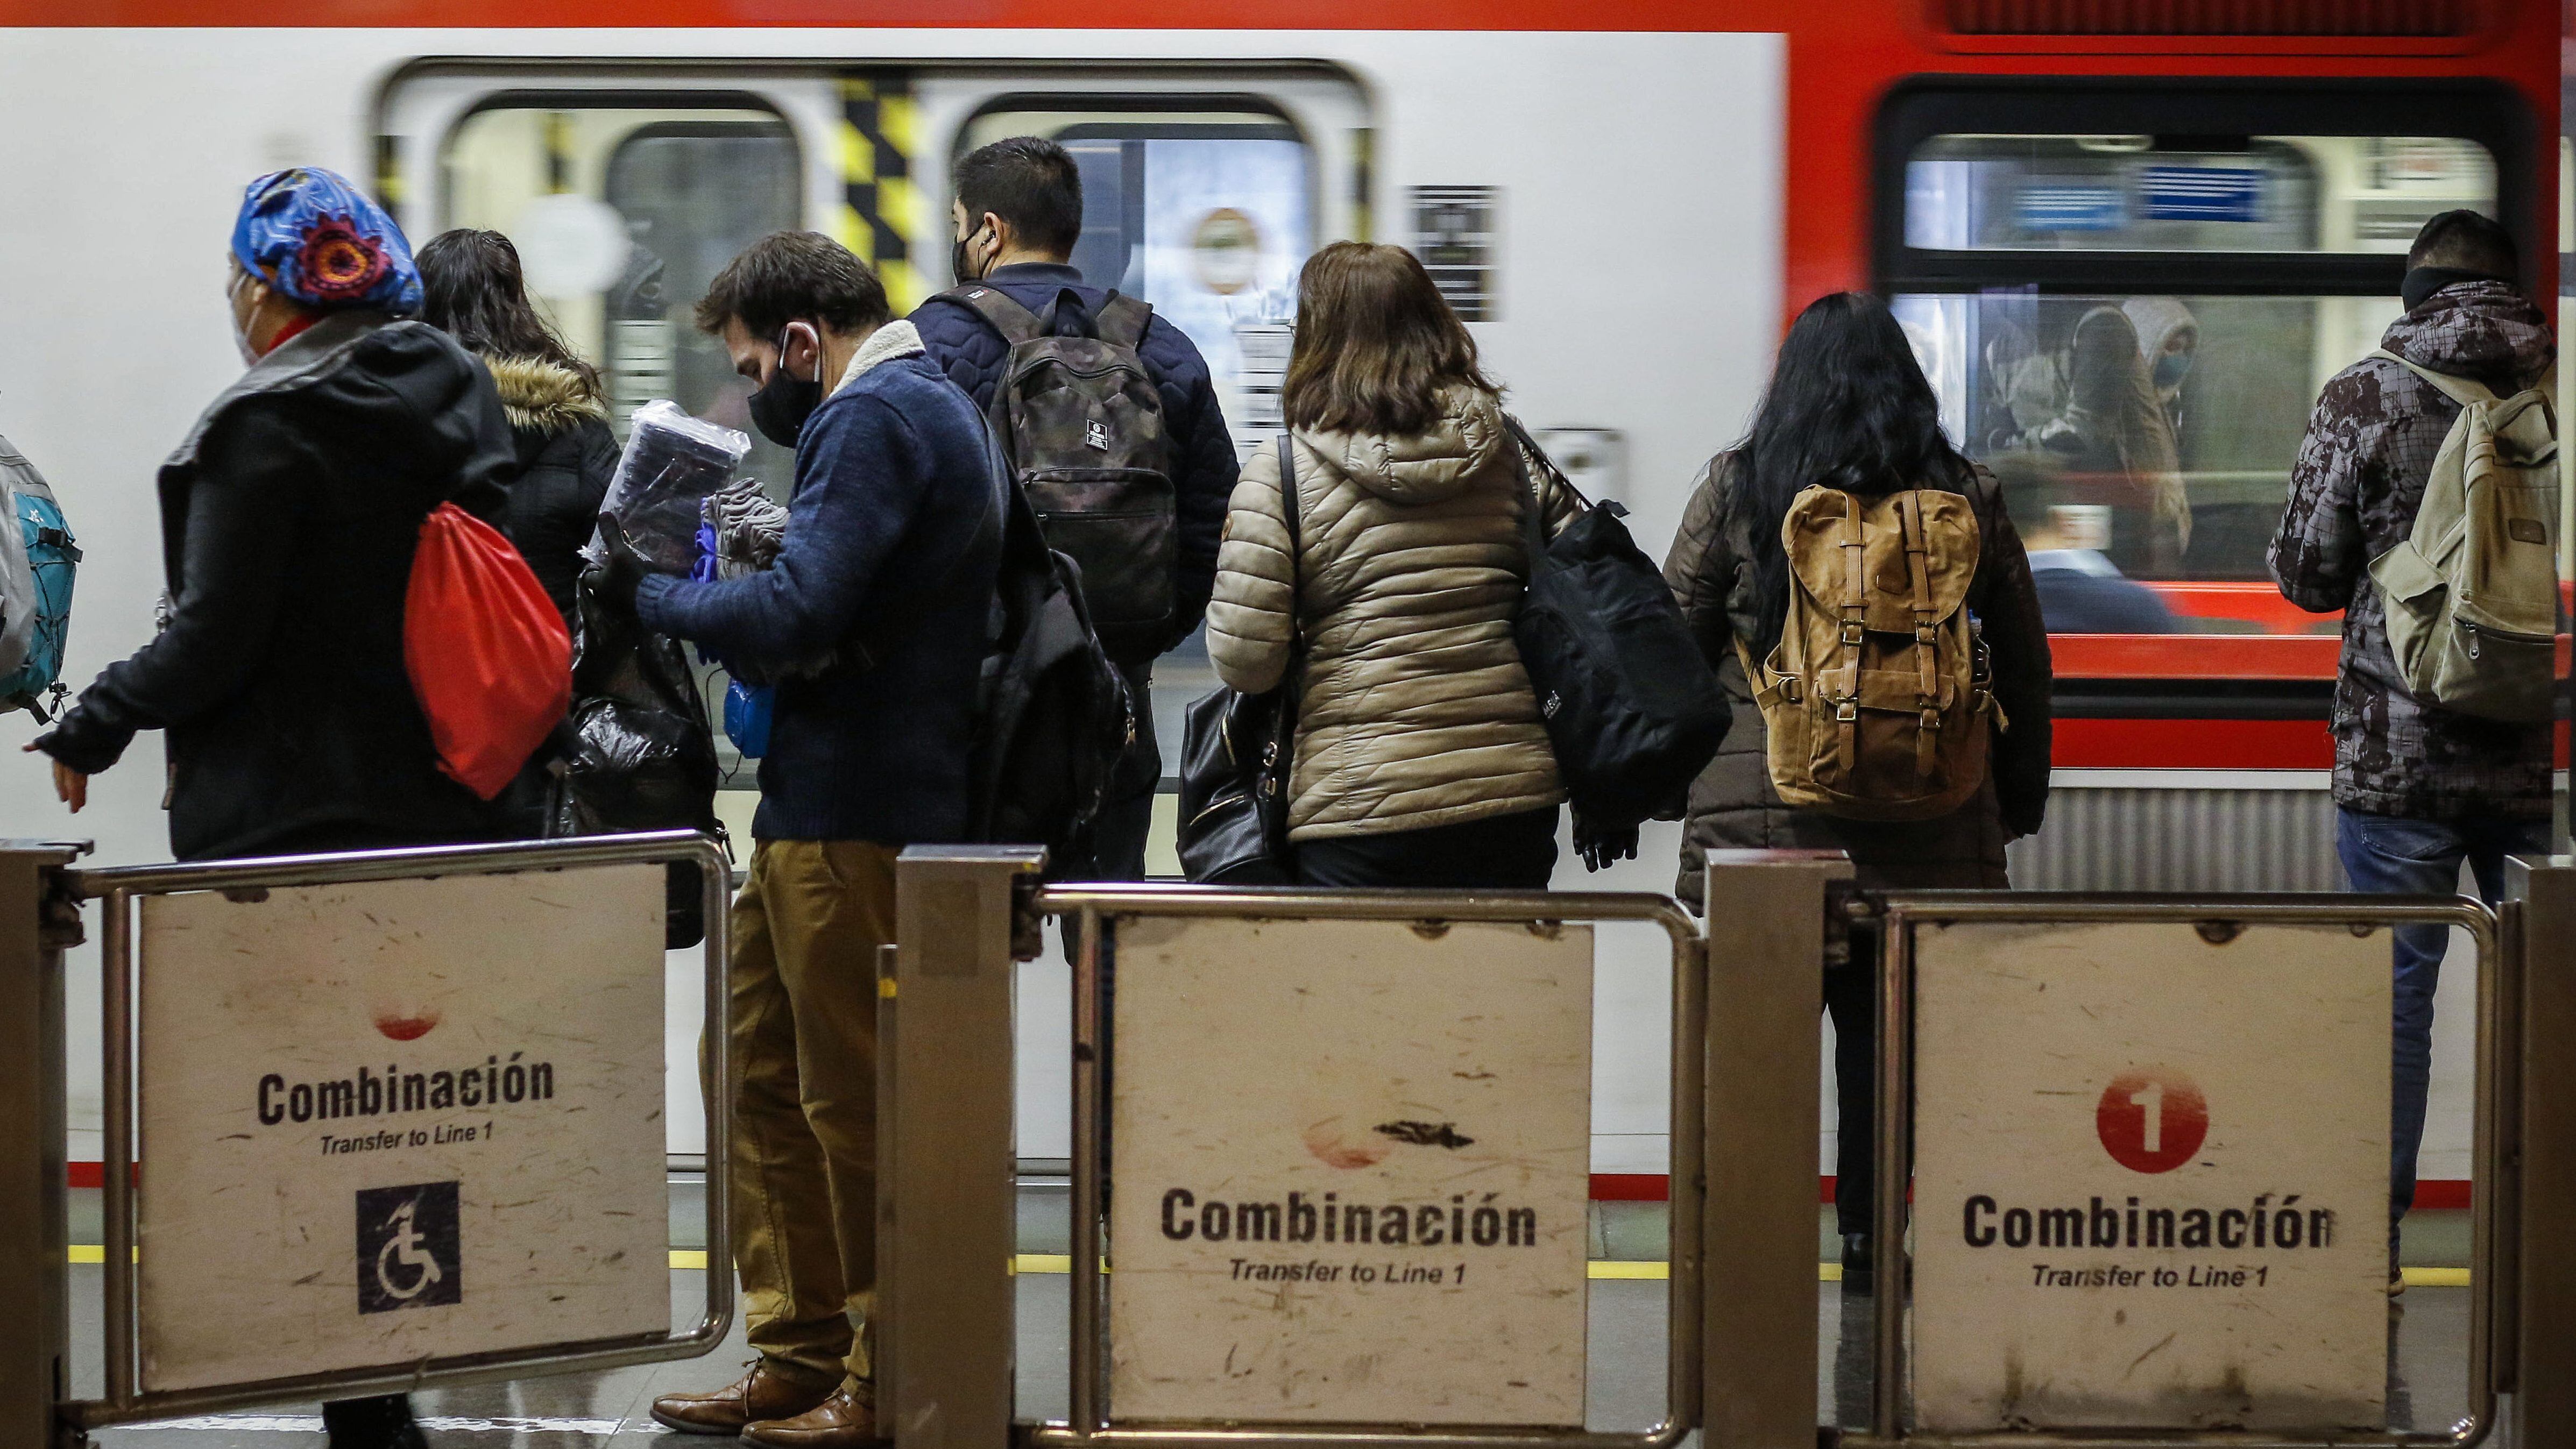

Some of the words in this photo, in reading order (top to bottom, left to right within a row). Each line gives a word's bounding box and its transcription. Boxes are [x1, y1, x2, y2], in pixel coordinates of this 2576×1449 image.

[257, 1051, 554, 1126] Combinación
[2129, 1081, 2163, 1152] 1
[321, 1130, 402, 1155] Transfer
[408, 1129, 428, 1147] to
[433, 1125, 477, 1144] Line
[484, 1121, 492, 1140] 1
[1161, 1188, 1537, 1247] Combinación
[1963, 1192, 2338, 1249] Combinación
[1229, 1259, 1342, 1282] Transfer
[1350, 1264, 1376, 1283] to
[1384, 1264, 1443, 1284] Line
[1455, 1263, 1466, 1284] 1
[2033, 1264, 2145, 1287] Transfer
[2153, 1267, 2179, 1287] to
[2187, 1265, 2247, 1288] Line
[2256, 1266, 2268, 1287] 1
